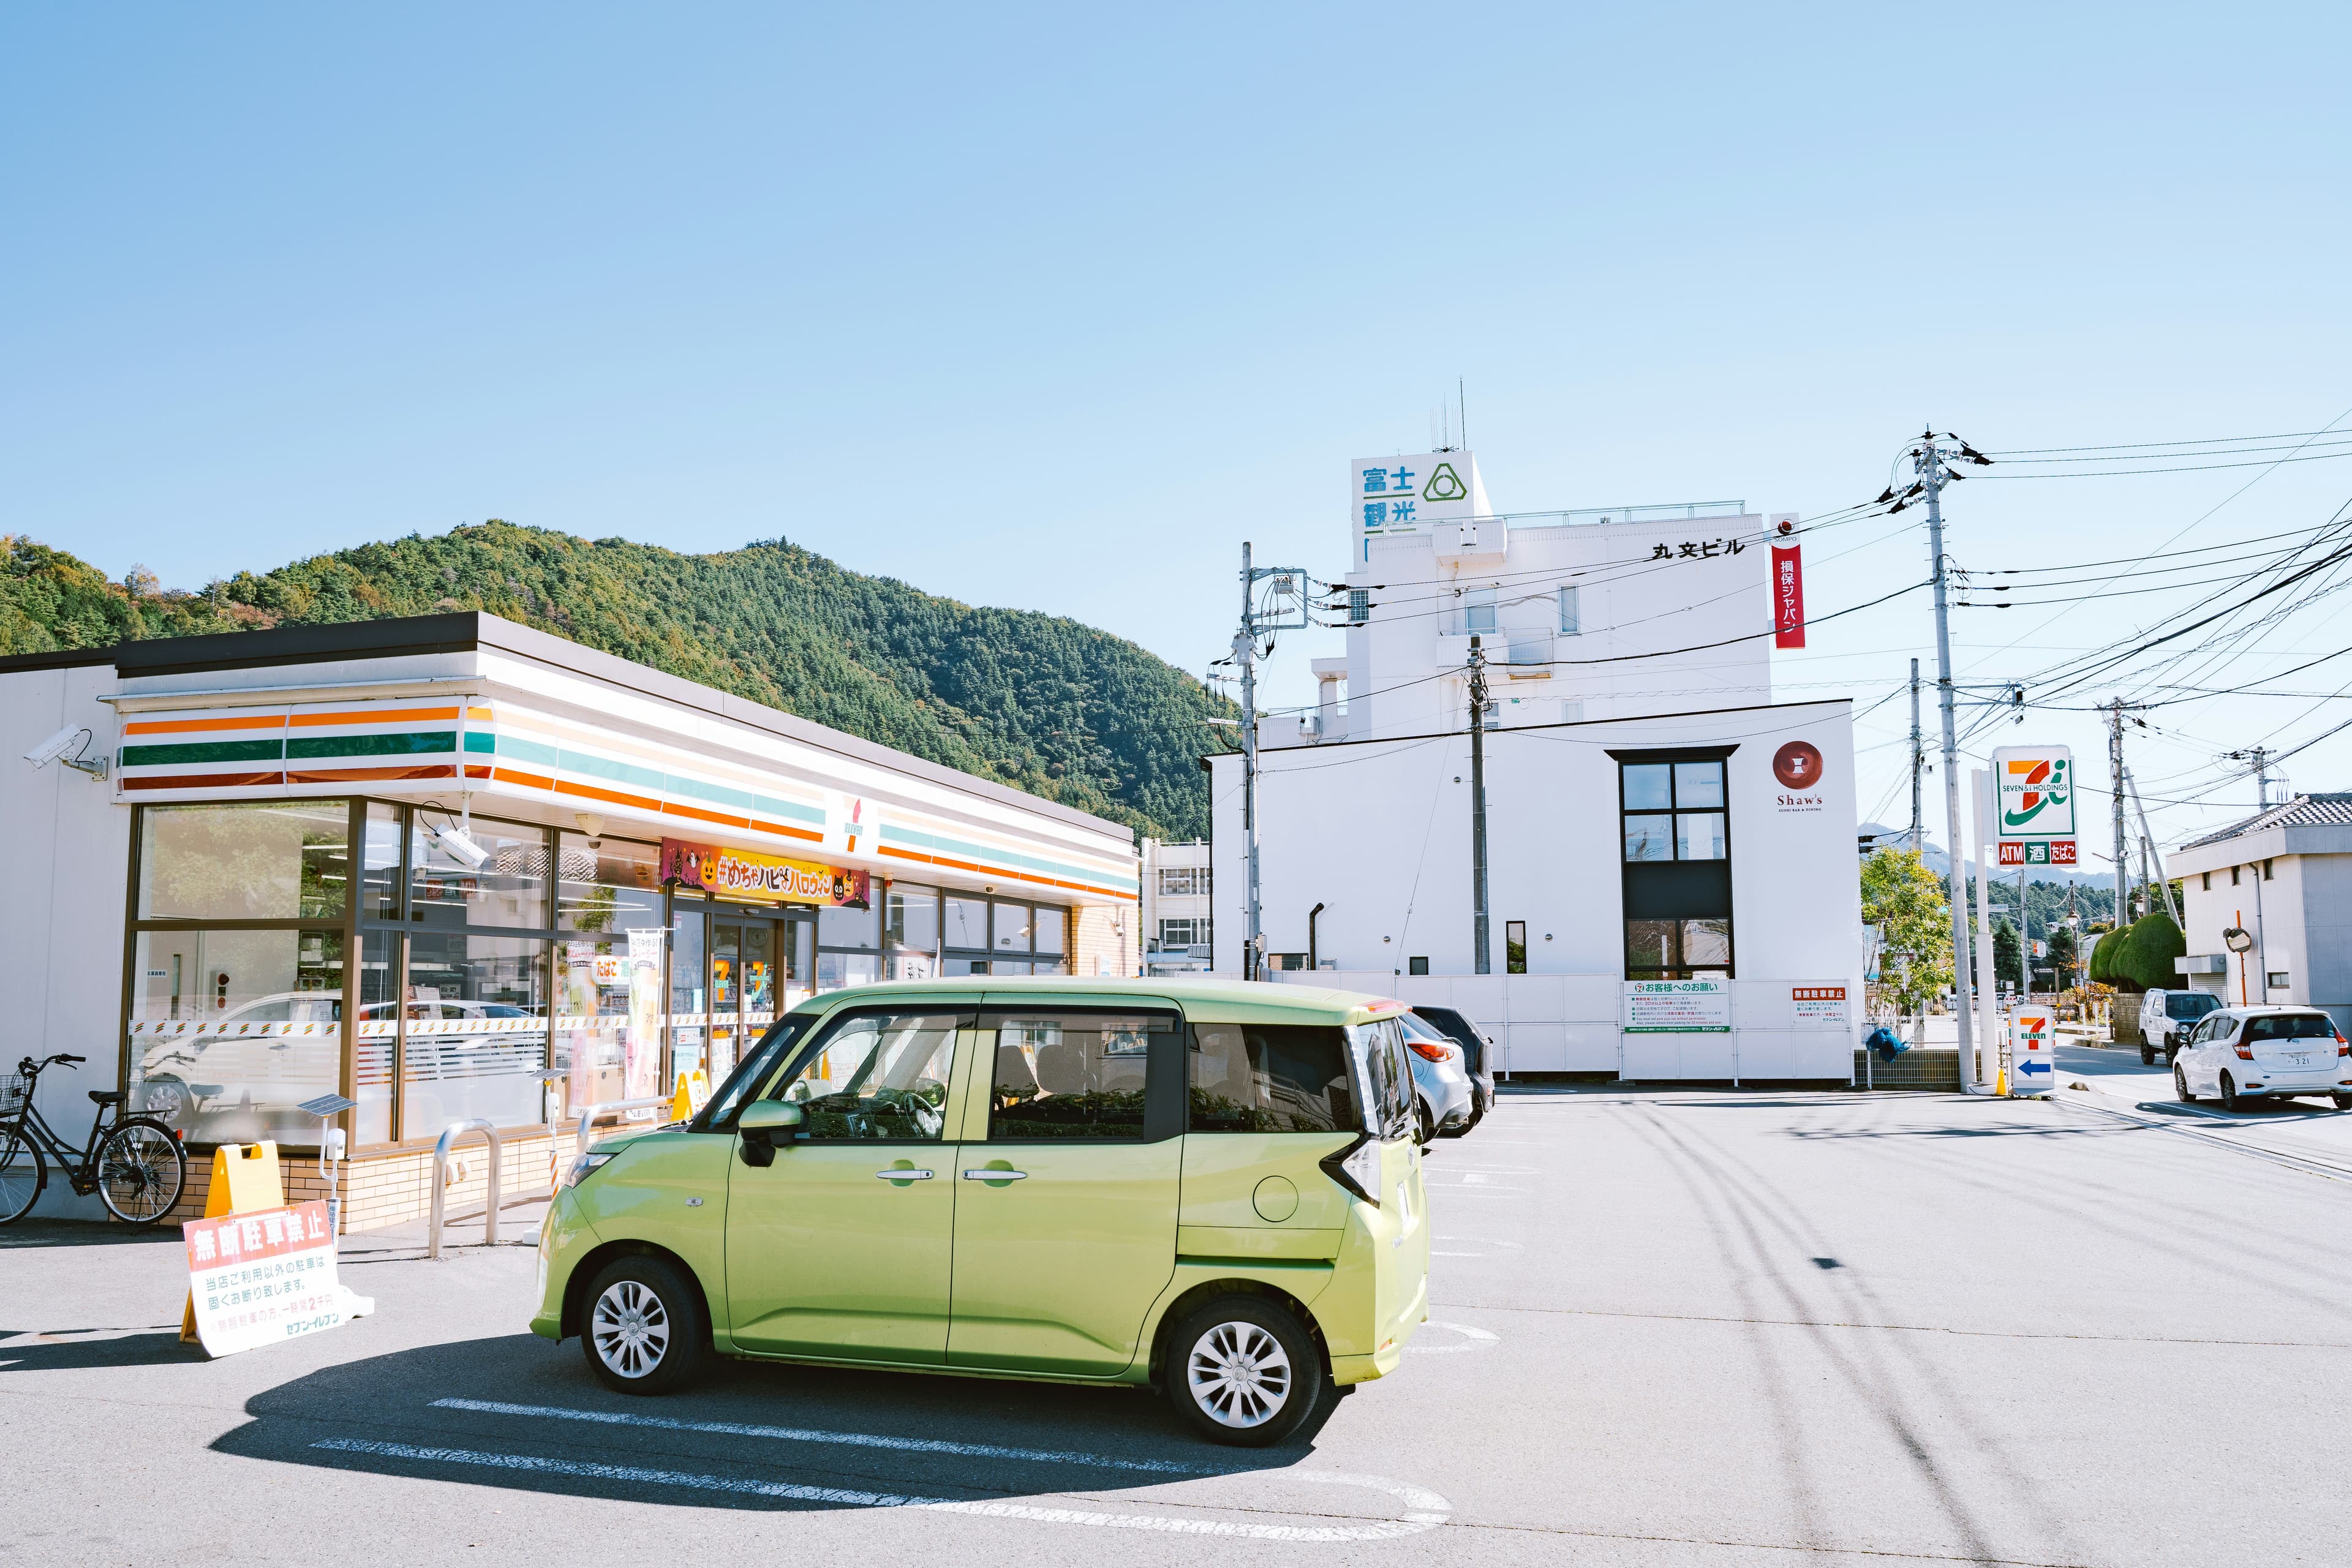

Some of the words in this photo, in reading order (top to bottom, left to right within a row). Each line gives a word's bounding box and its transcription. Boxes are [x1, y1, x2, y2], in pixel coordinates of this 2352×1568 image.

[1363, 466, 1415, 492] 富士
[1364, 500, 1416, 527] 観光
[1652, 538, 1746, 559] 丸文ビル
[1781, 560, 1796, 633] 損保ジャパン
[1777, 794, 1822, 805] Shaw's
[2000, 846, 2024, 861] ATM
[2029, 845, 2046, 861] 酒
[2051, 844, 2076, 861] たばこ
[597, 960, 617, 976] たばこ
[1646, 983, 1717, 992] お客様へのお願い
[1794, 989, 1844, 998] 無断駐車禁止
[194, 1210, 325, 1262] 無断駐車禁止
[206, 1256, 325, 1292] 当店ご利用以外の駐車は
[208, 1278, 306, 1310] 固くお断り致します。
